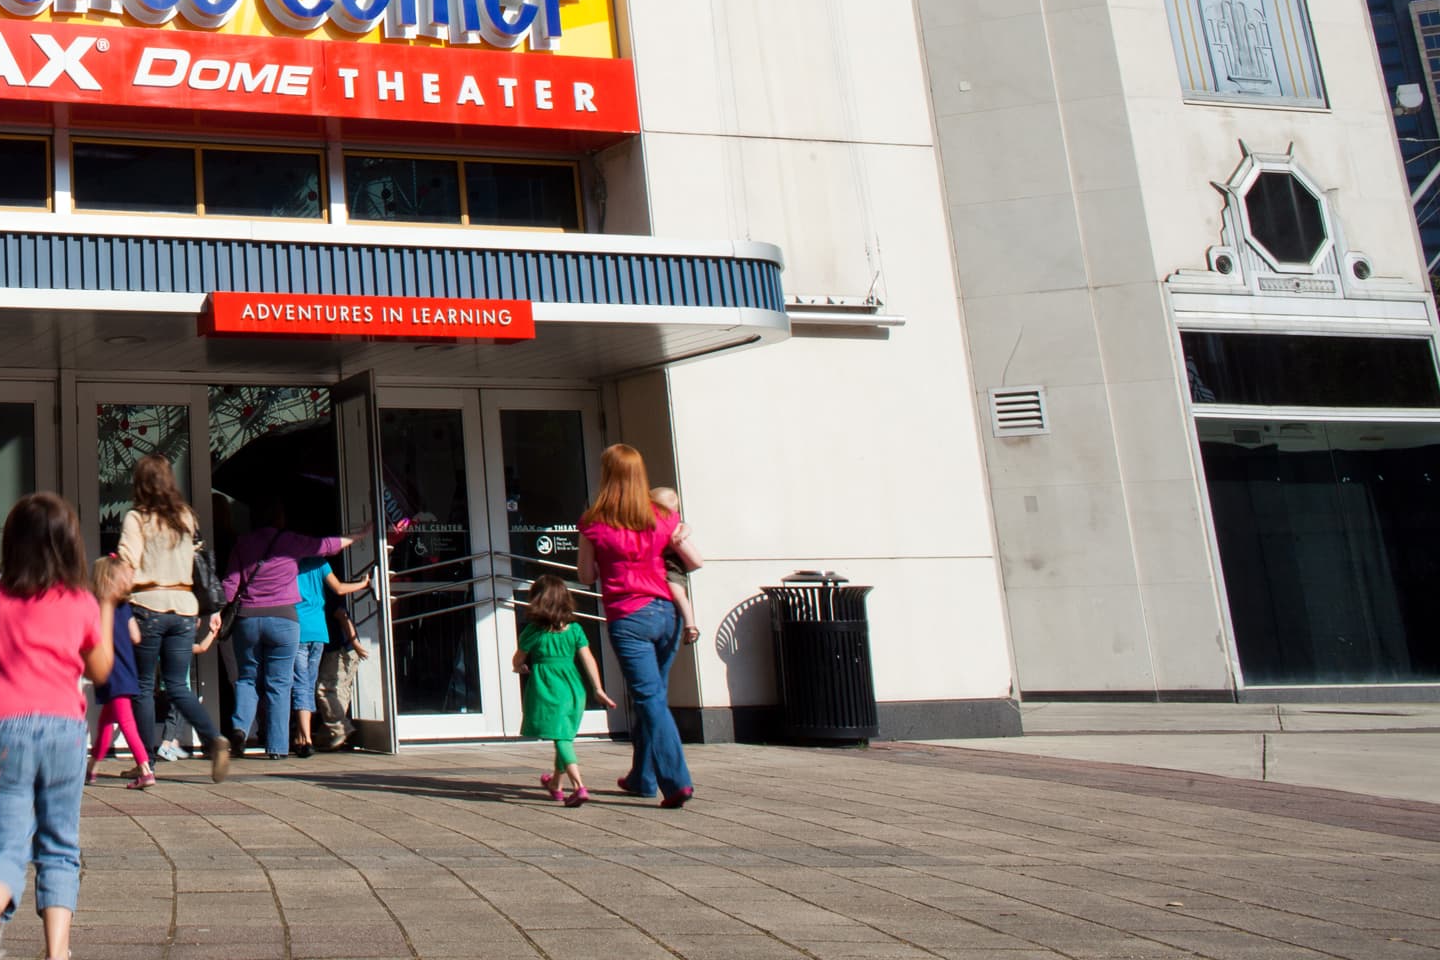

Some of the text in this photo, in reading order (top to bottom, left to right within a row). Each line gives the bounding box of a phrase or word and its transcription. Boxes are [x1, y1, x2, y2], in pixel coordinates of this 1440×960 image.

[337, 67, 598, 113] THEATER
[241, 303, 512, 326] ADVENTURES IN LEARNING
